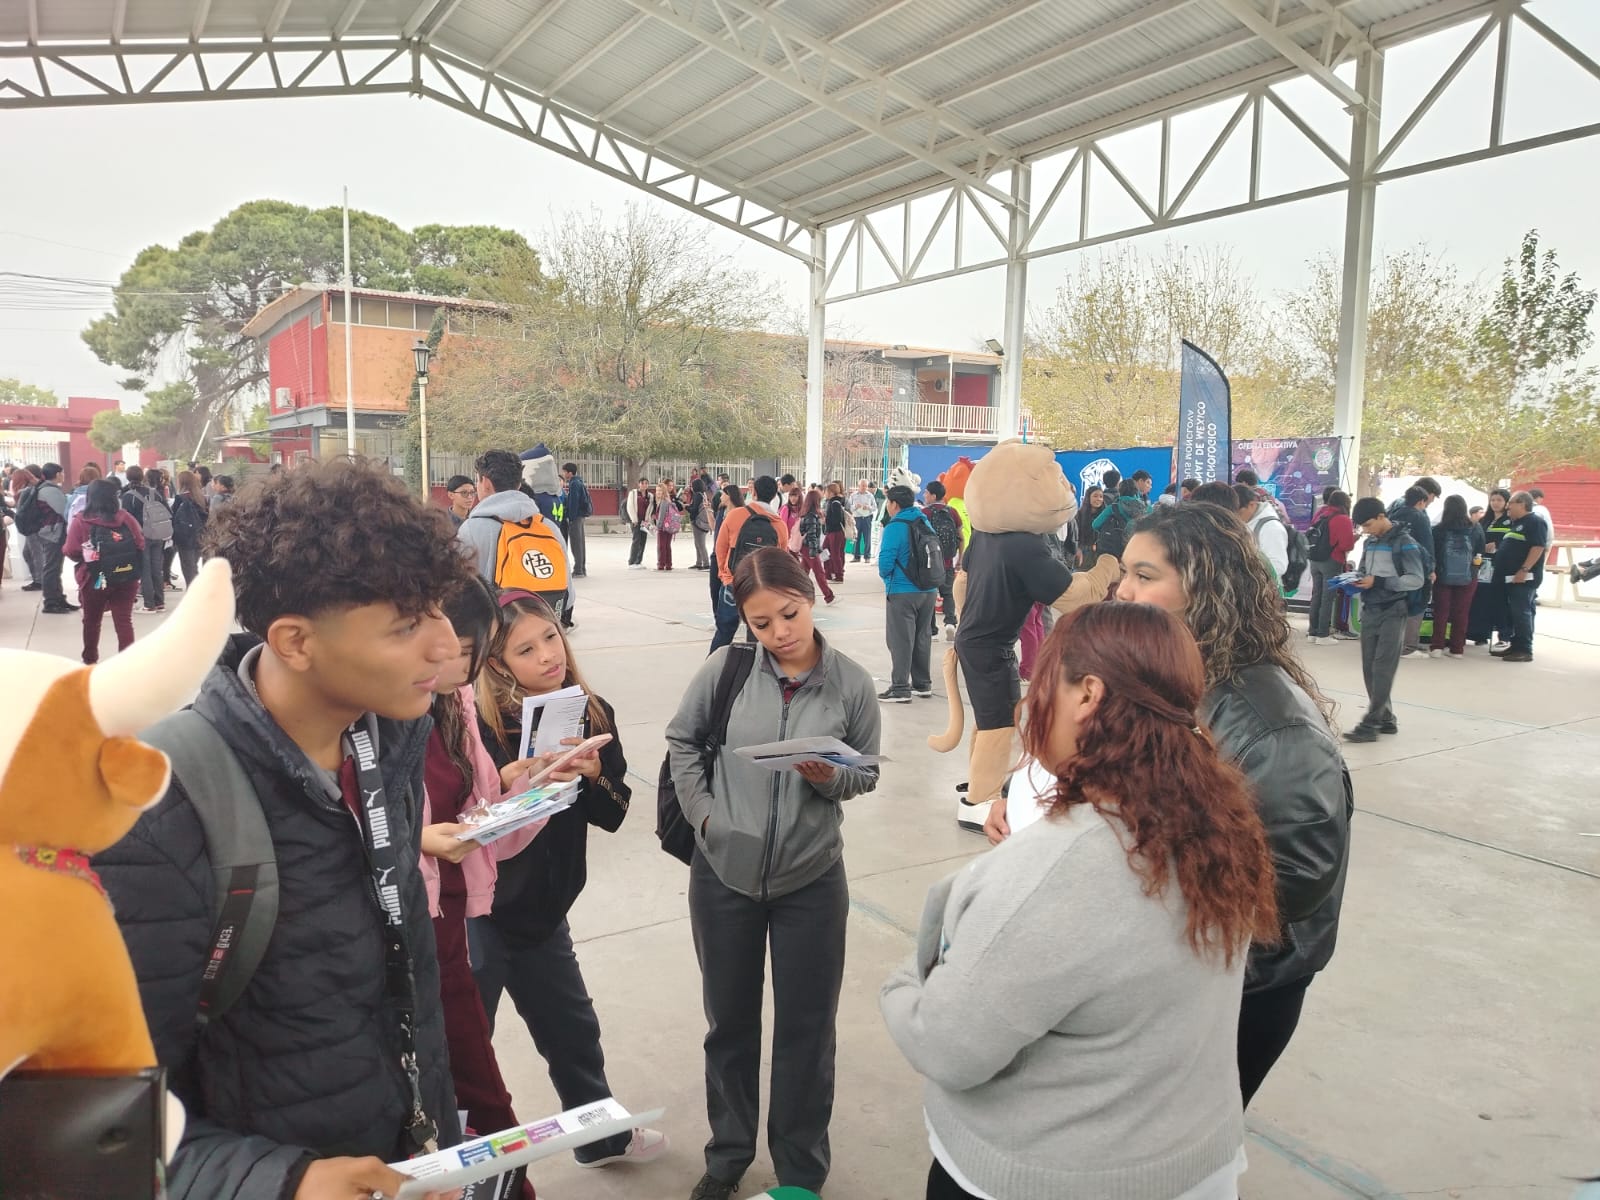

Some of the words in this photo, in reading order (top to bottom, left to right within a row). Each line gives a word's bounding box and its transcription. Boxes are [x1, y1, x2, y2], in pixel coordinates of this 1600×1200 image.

[1263, 440, 1298, 449] EDUCATIVA
[525, 552, 552, 577] 悟
[351, 730, 376, 771] PUMA
[368, 806, 391, 849] PUMA
[381, 884, 402, 925] PUMA
